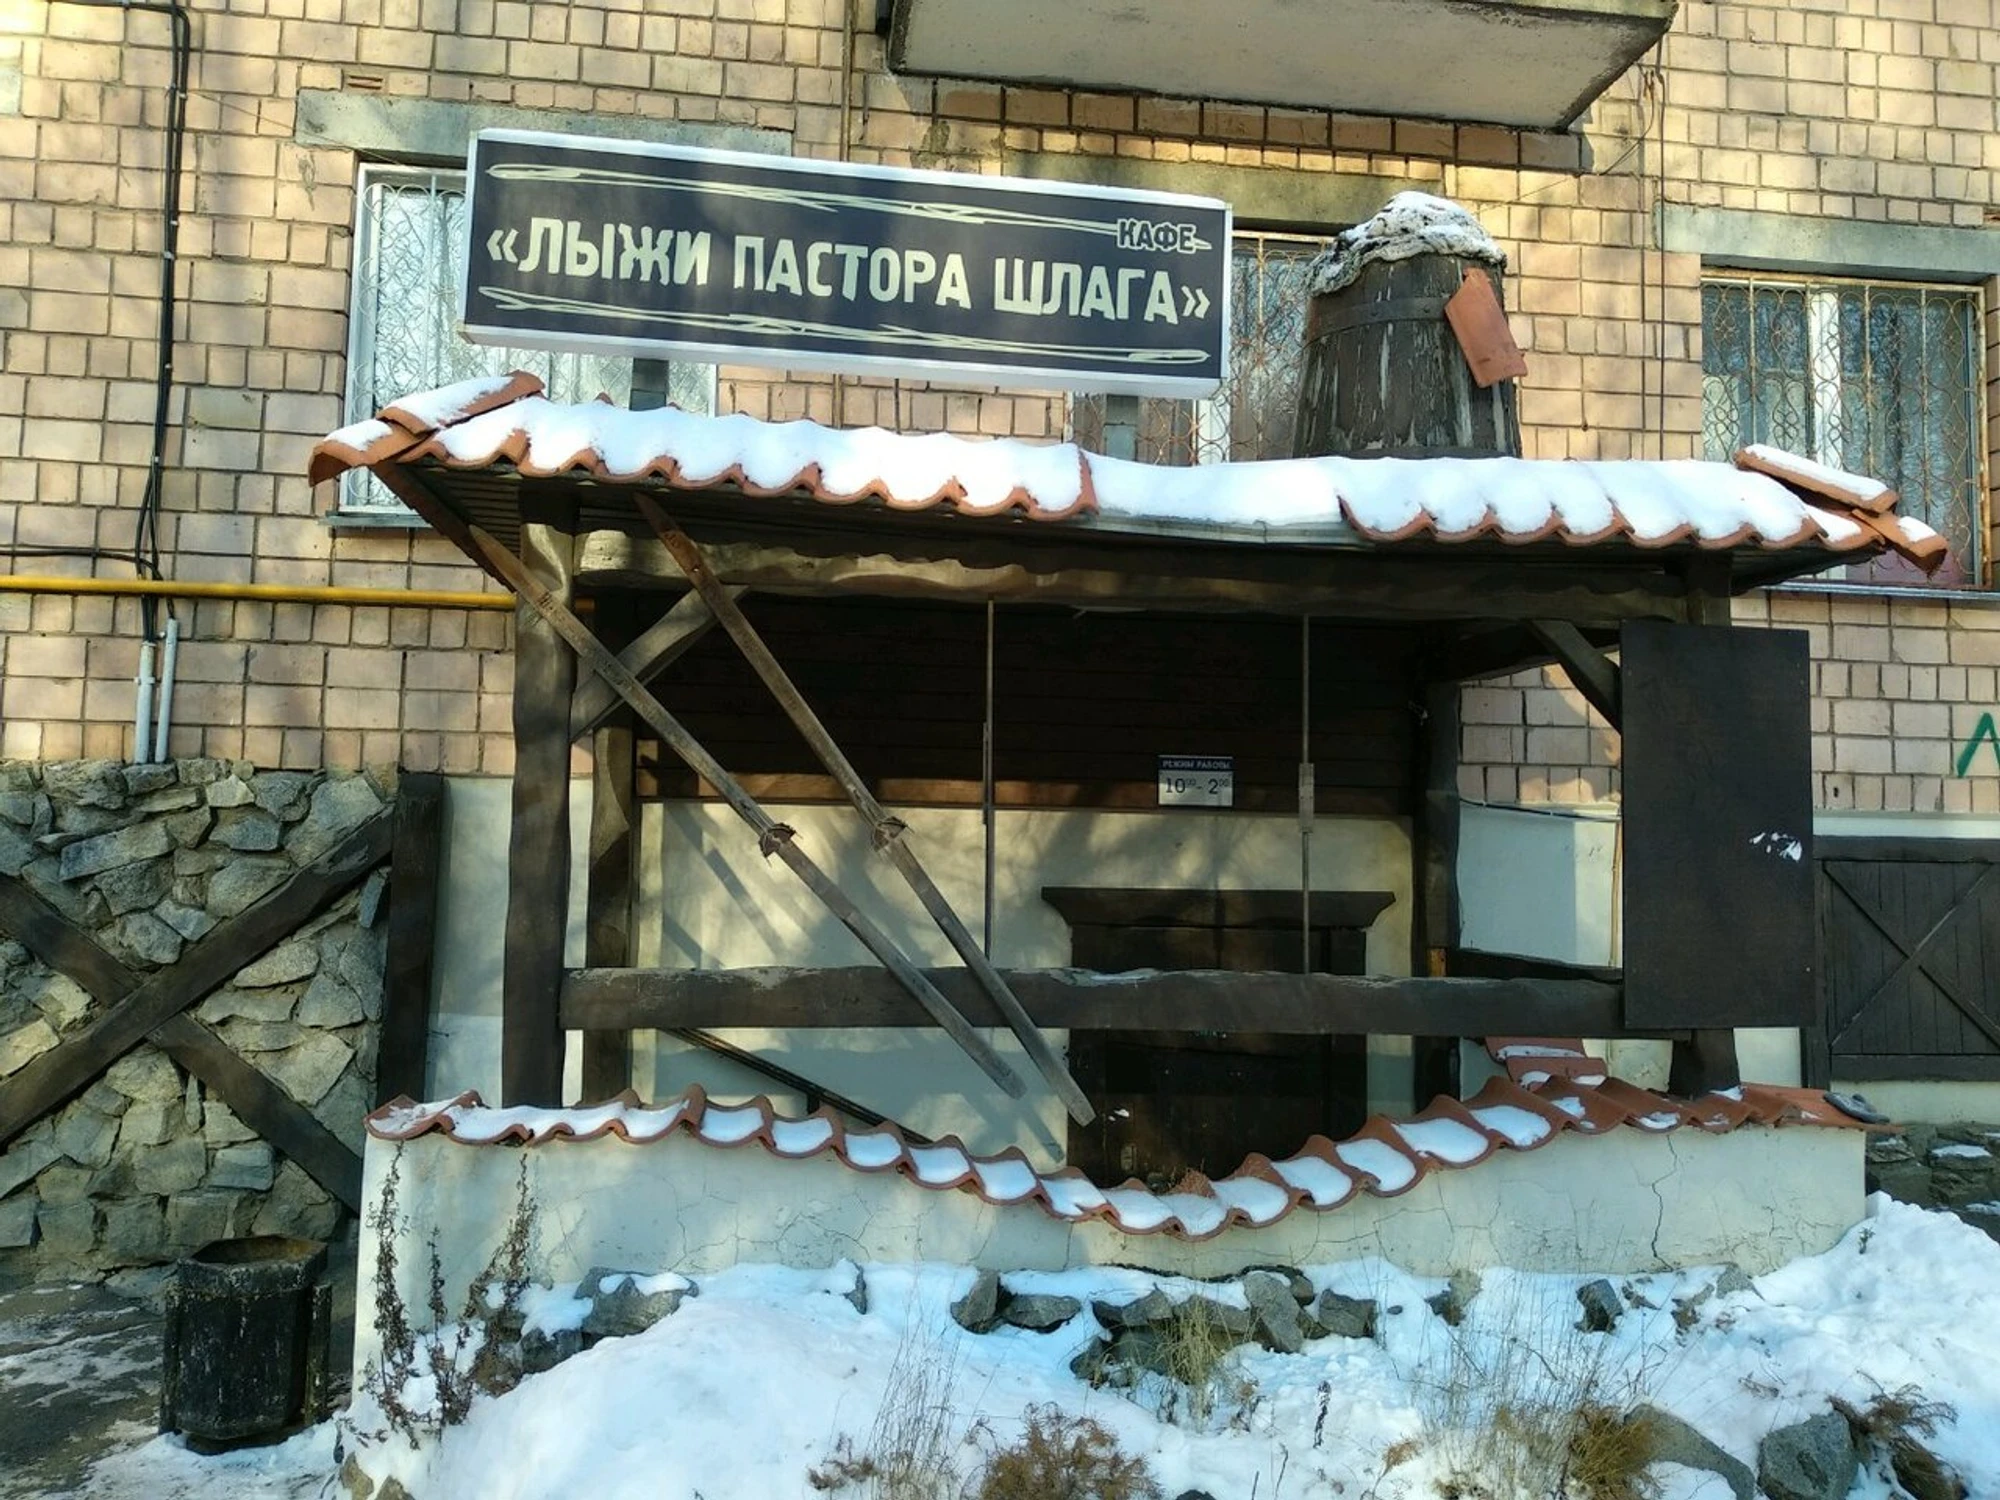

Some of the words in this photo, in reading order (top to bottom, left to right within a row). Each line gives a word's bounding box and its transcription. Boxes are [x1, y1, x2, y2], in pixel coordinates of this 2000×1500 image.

[486, 217, 711, 286] «ЛЫЖИ
[733, 235, 972, 309] ПАСТОРА
[994, 257, 1212, 325] ШЛАГА»
[1117, 217, 1197, 254] КАФЕ
